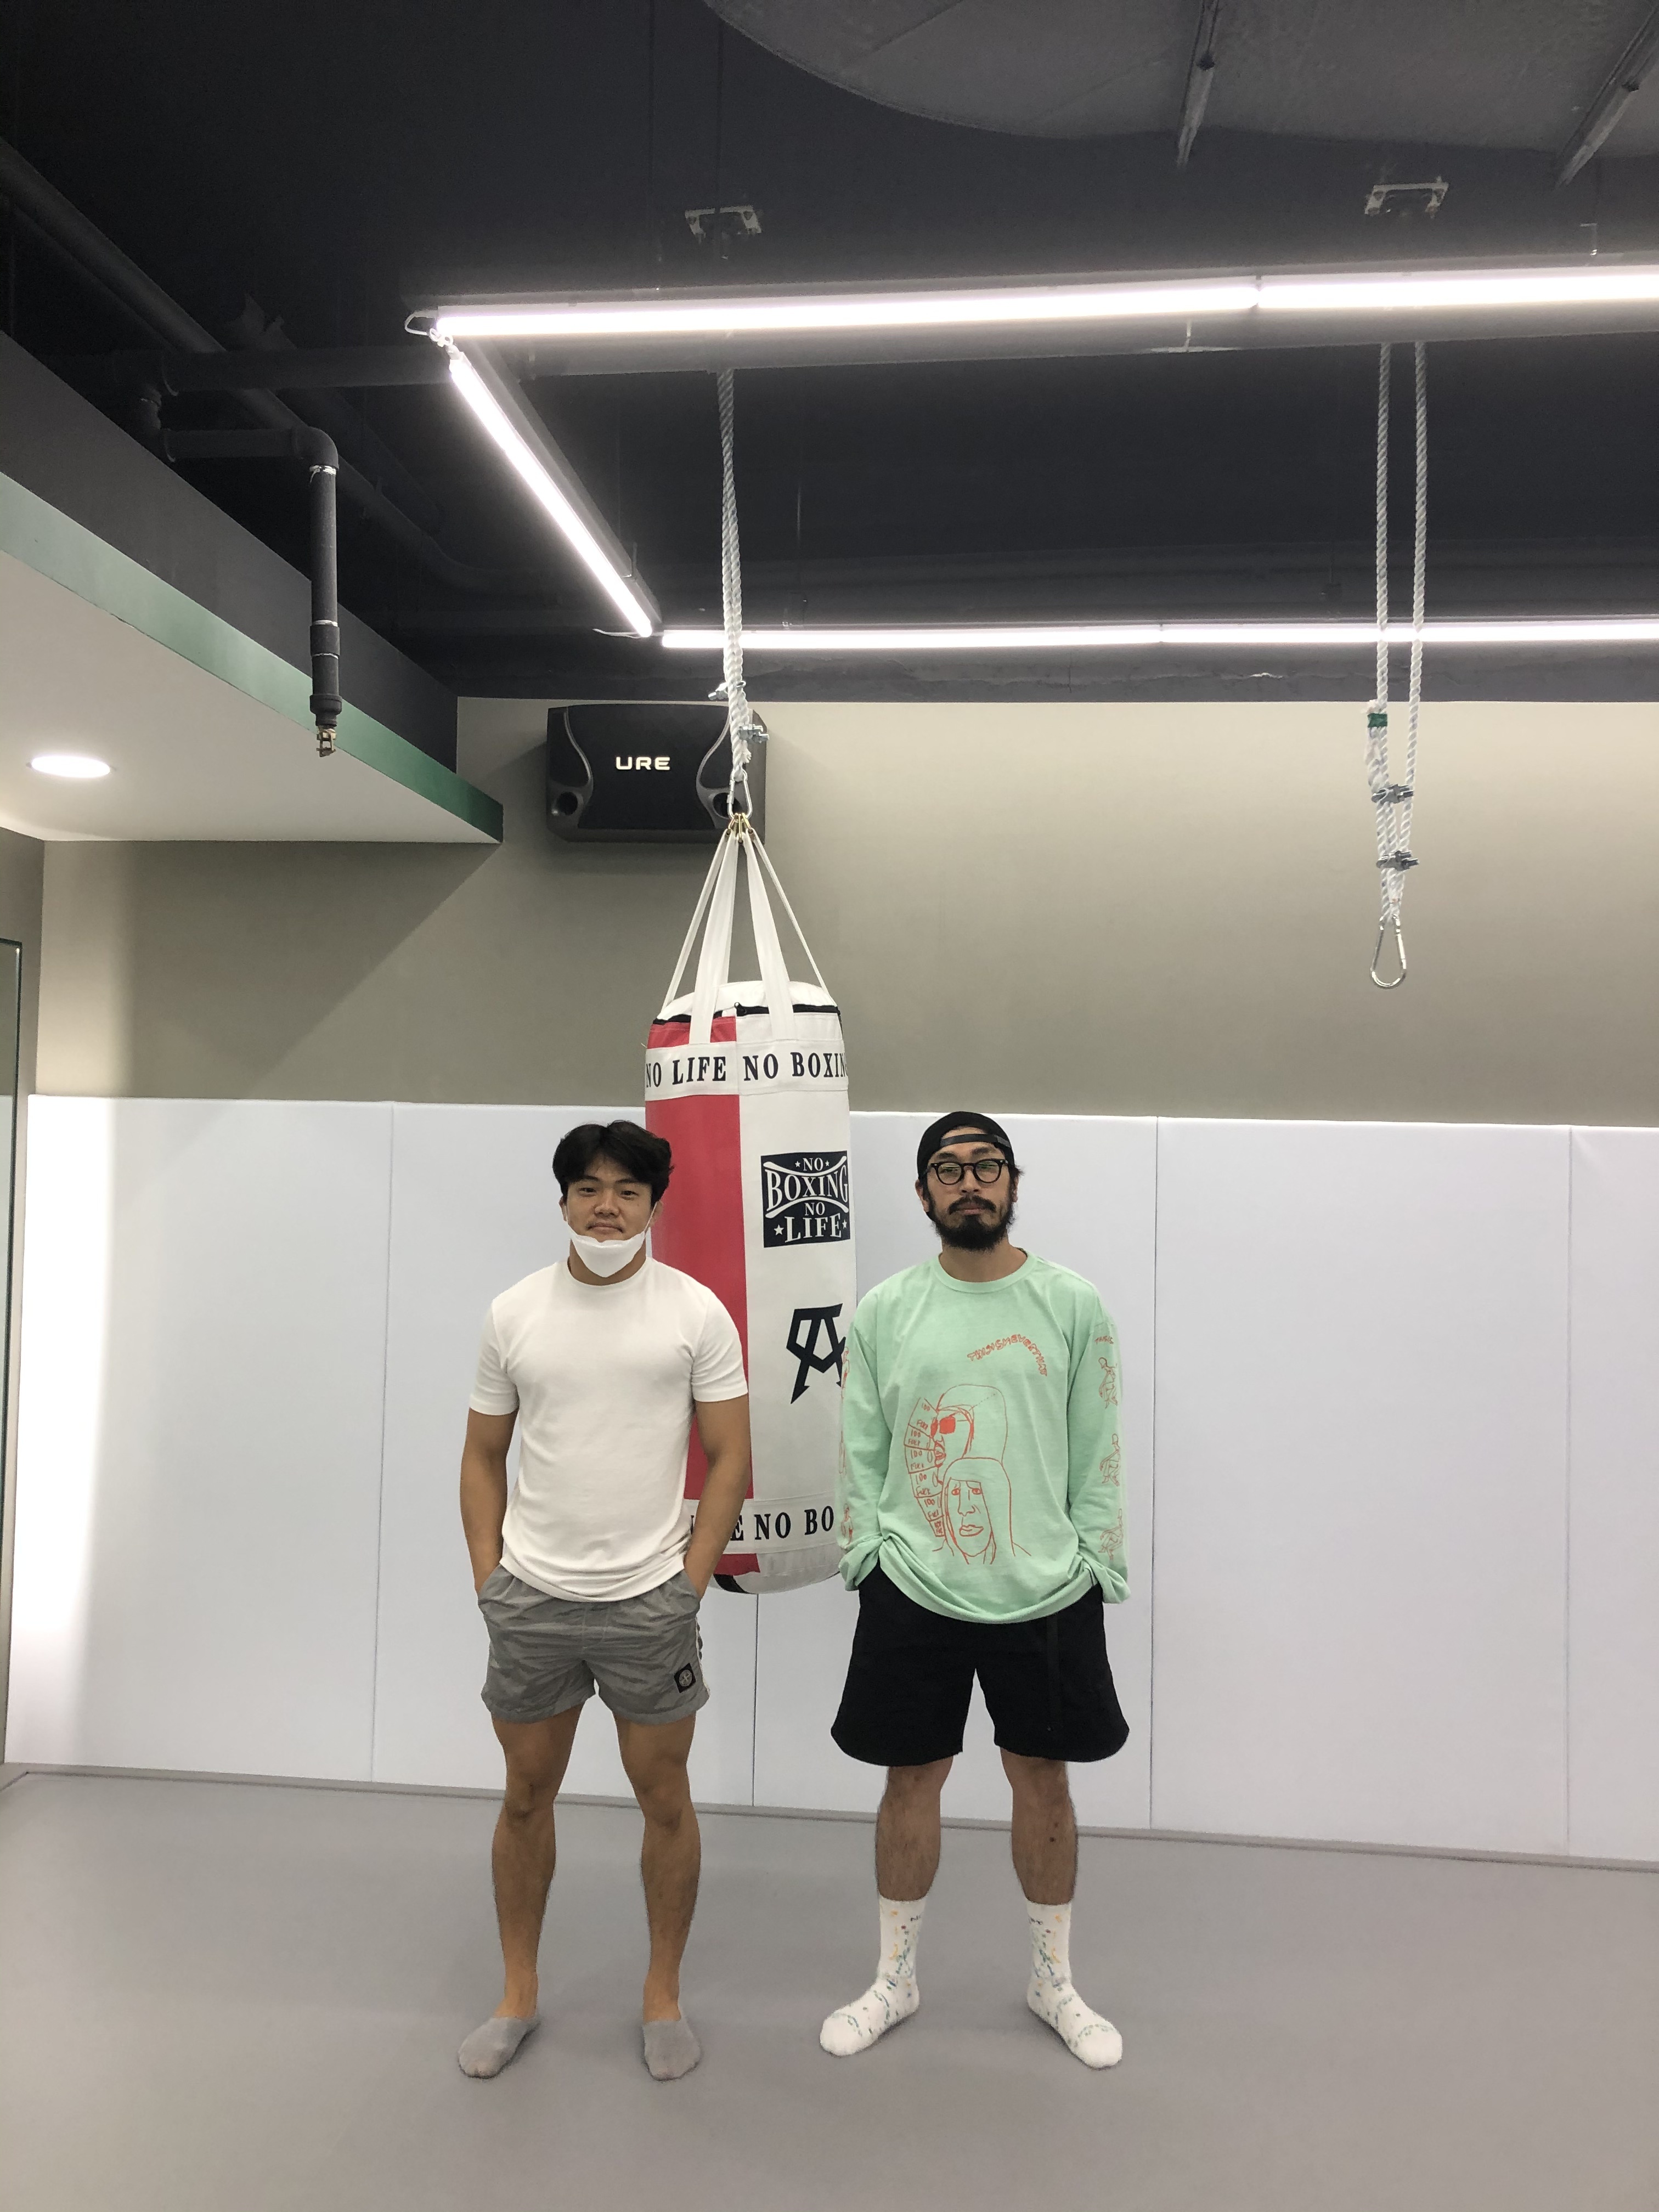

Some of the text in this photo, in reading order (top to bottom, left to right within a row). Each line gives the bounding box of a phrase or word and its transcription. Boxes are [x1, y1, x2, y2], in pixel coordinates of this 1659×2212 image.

[616, 757, 670, 770] URE
[646, 1052, 848, 1087] NO LIFE NO BOXIN
[802, 1158, 823, 1171] NO
[765, 1164, 848, 1211] BOXING
[804, 1201, 825, 1216] NO
[784, 1212, 842, 1243] LIFE
[754, 1512, 791, 1540] NO
